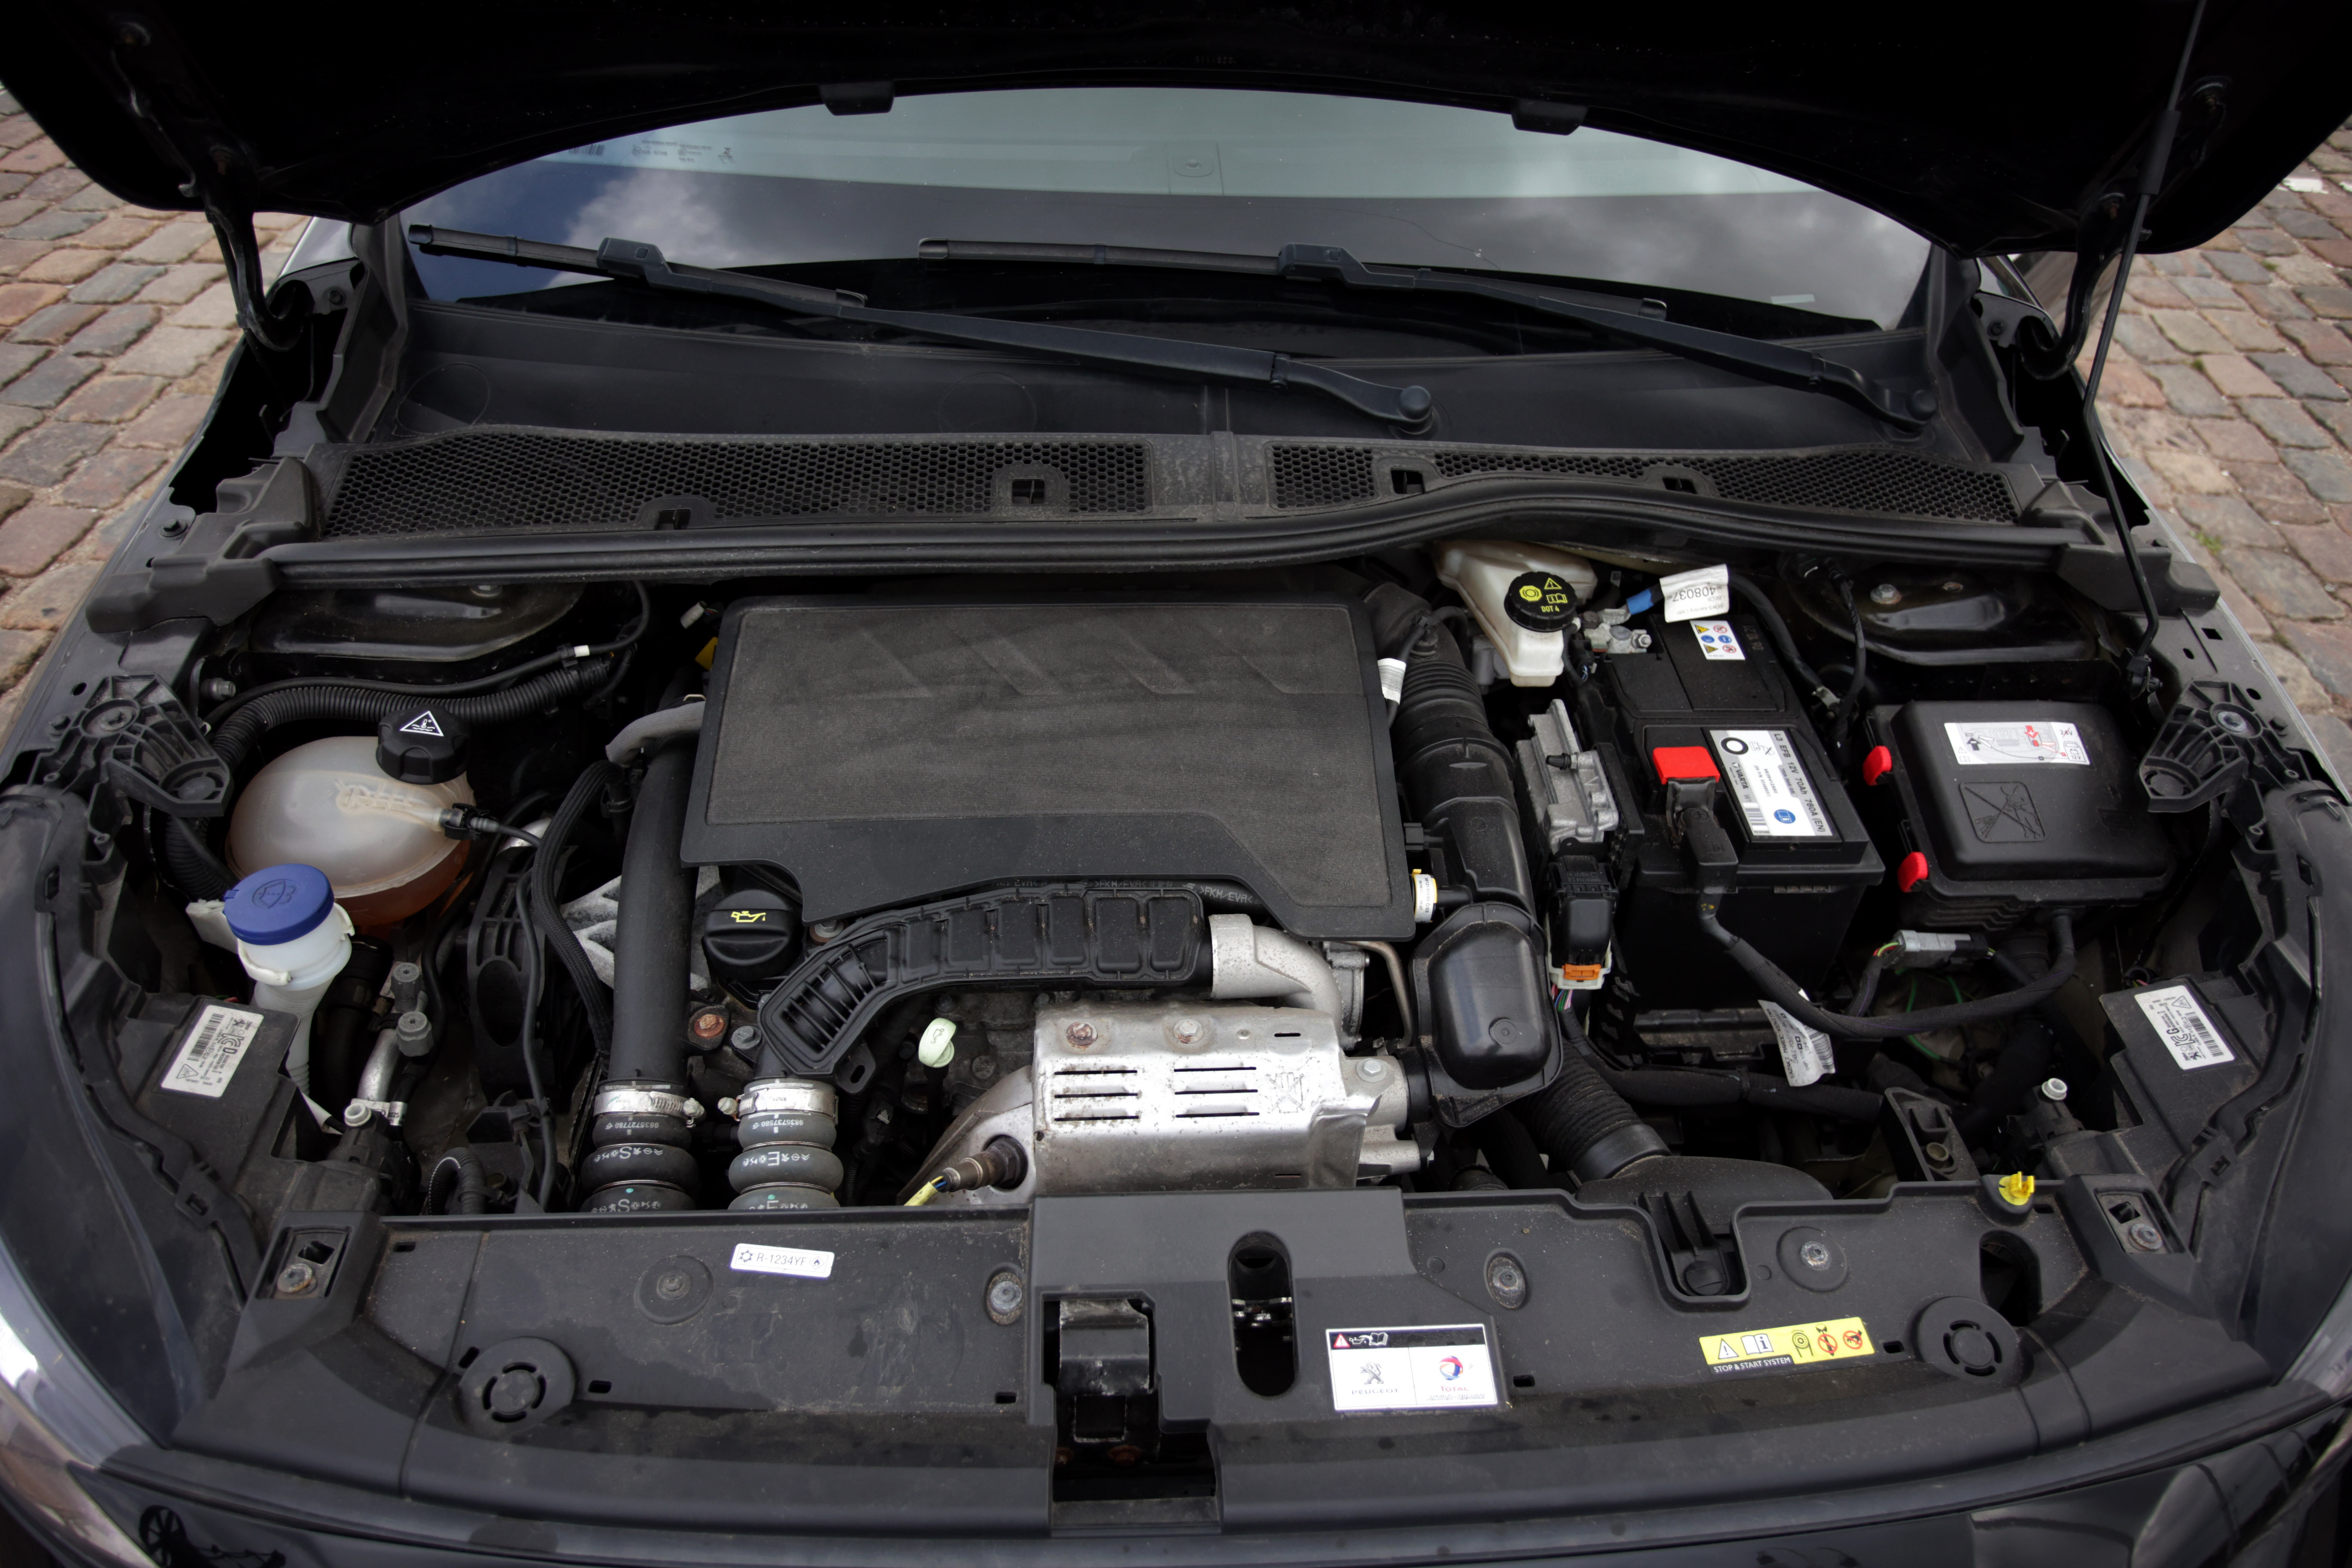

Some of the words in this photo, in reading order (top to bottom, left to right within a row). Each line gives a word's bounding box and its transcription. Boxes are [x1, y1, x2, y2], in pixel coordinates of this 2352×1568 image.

[1735, 769, 1749, 789] VARTA
[1774, 733, 1783, 741] L3
[1779, 745, 1791, 758] EFB
[1788, 762, 1799, 774] 12V
[1795, 778, 1807, 794] 70Ah
[1805, 799, 1818, 816] 760A
[1812, 818, 1826, 832] (EN)
[1785, 1057, 1794, 1079] YAZAKI
[756, 1253, 807, 1266] R-1234YF
[1714, 1364, 1733, 1373] STOP
[1741, 1360, 1762, 1369] START
[1764, 1357, 1791, 1366] SYSTEM
